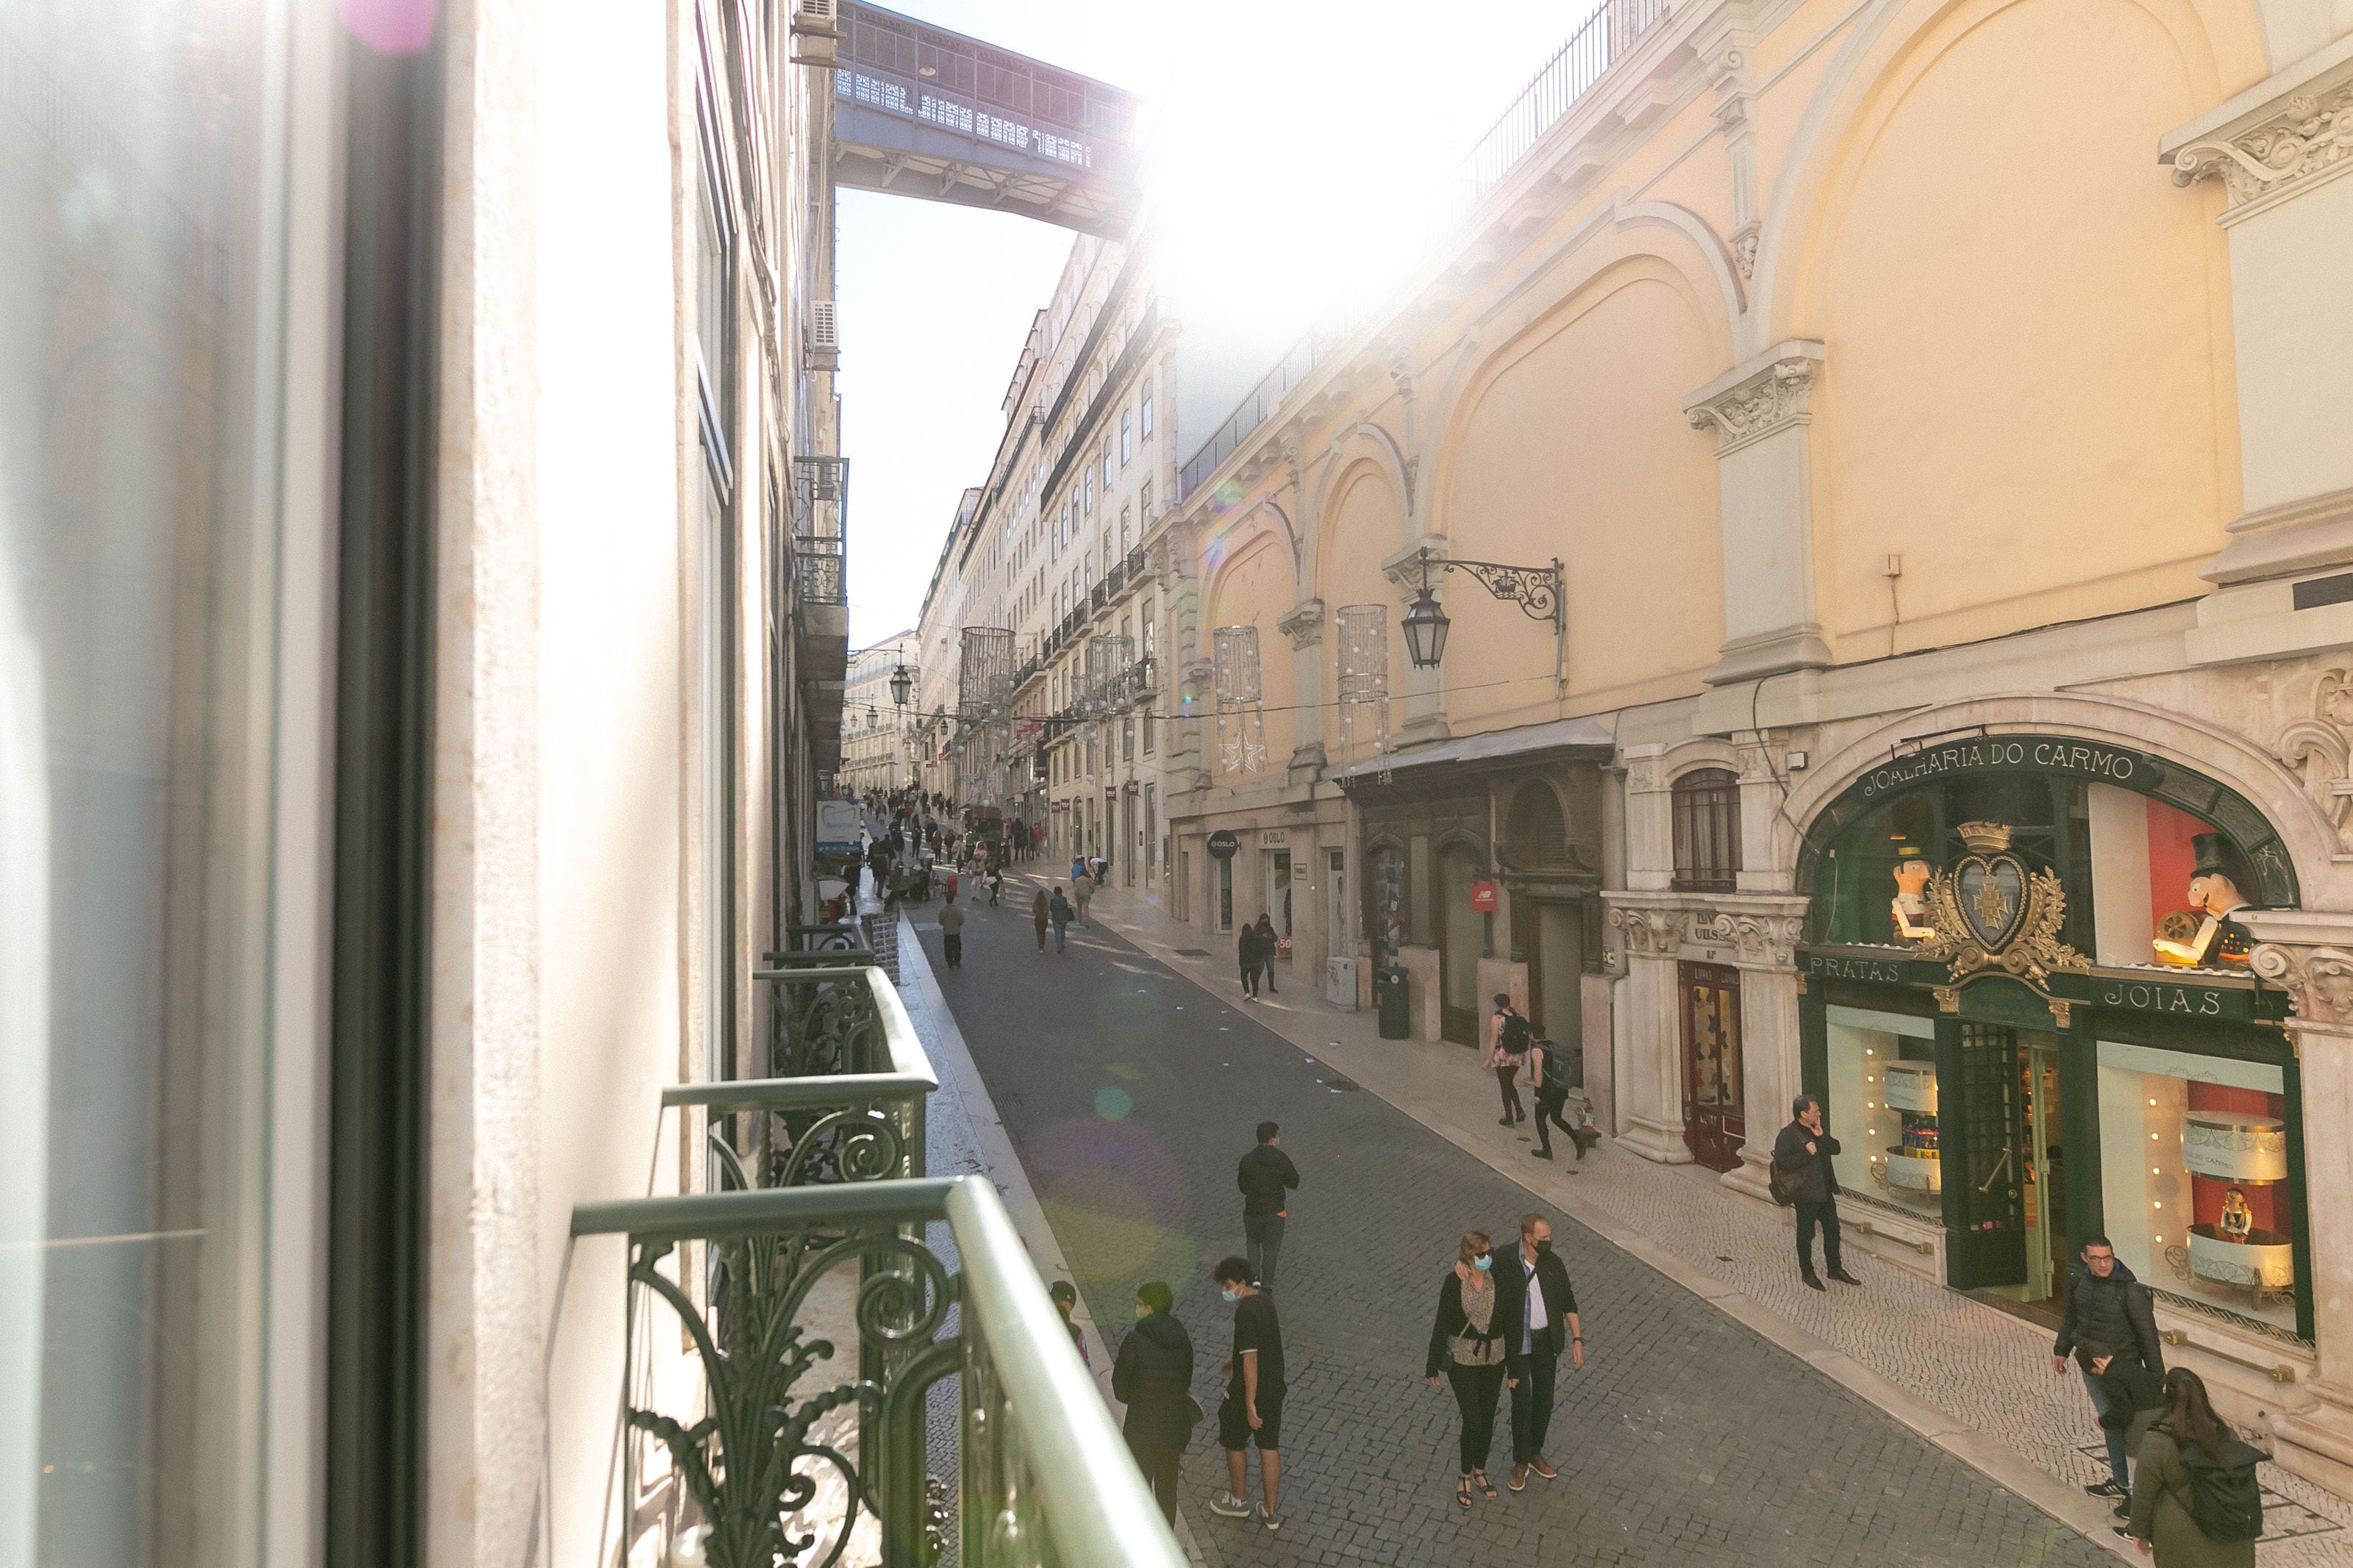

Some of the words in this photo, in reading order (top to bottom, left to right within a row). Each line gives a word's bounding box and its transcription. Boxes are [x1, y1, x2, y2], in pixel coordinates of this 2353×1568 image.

[1864, 745, 1984, 796] JOALHARIA
[1991, 743, 2023, 765] DO
[2035, 743, 2133, 779] CARMO
[1269, 831, 1285, 844] OSLO
[1697, 913, 1717, 925] LUV
[1810, 957, 1899, 982] PRATAS
[2104, 984, 2221, 1015] JÓIAS
